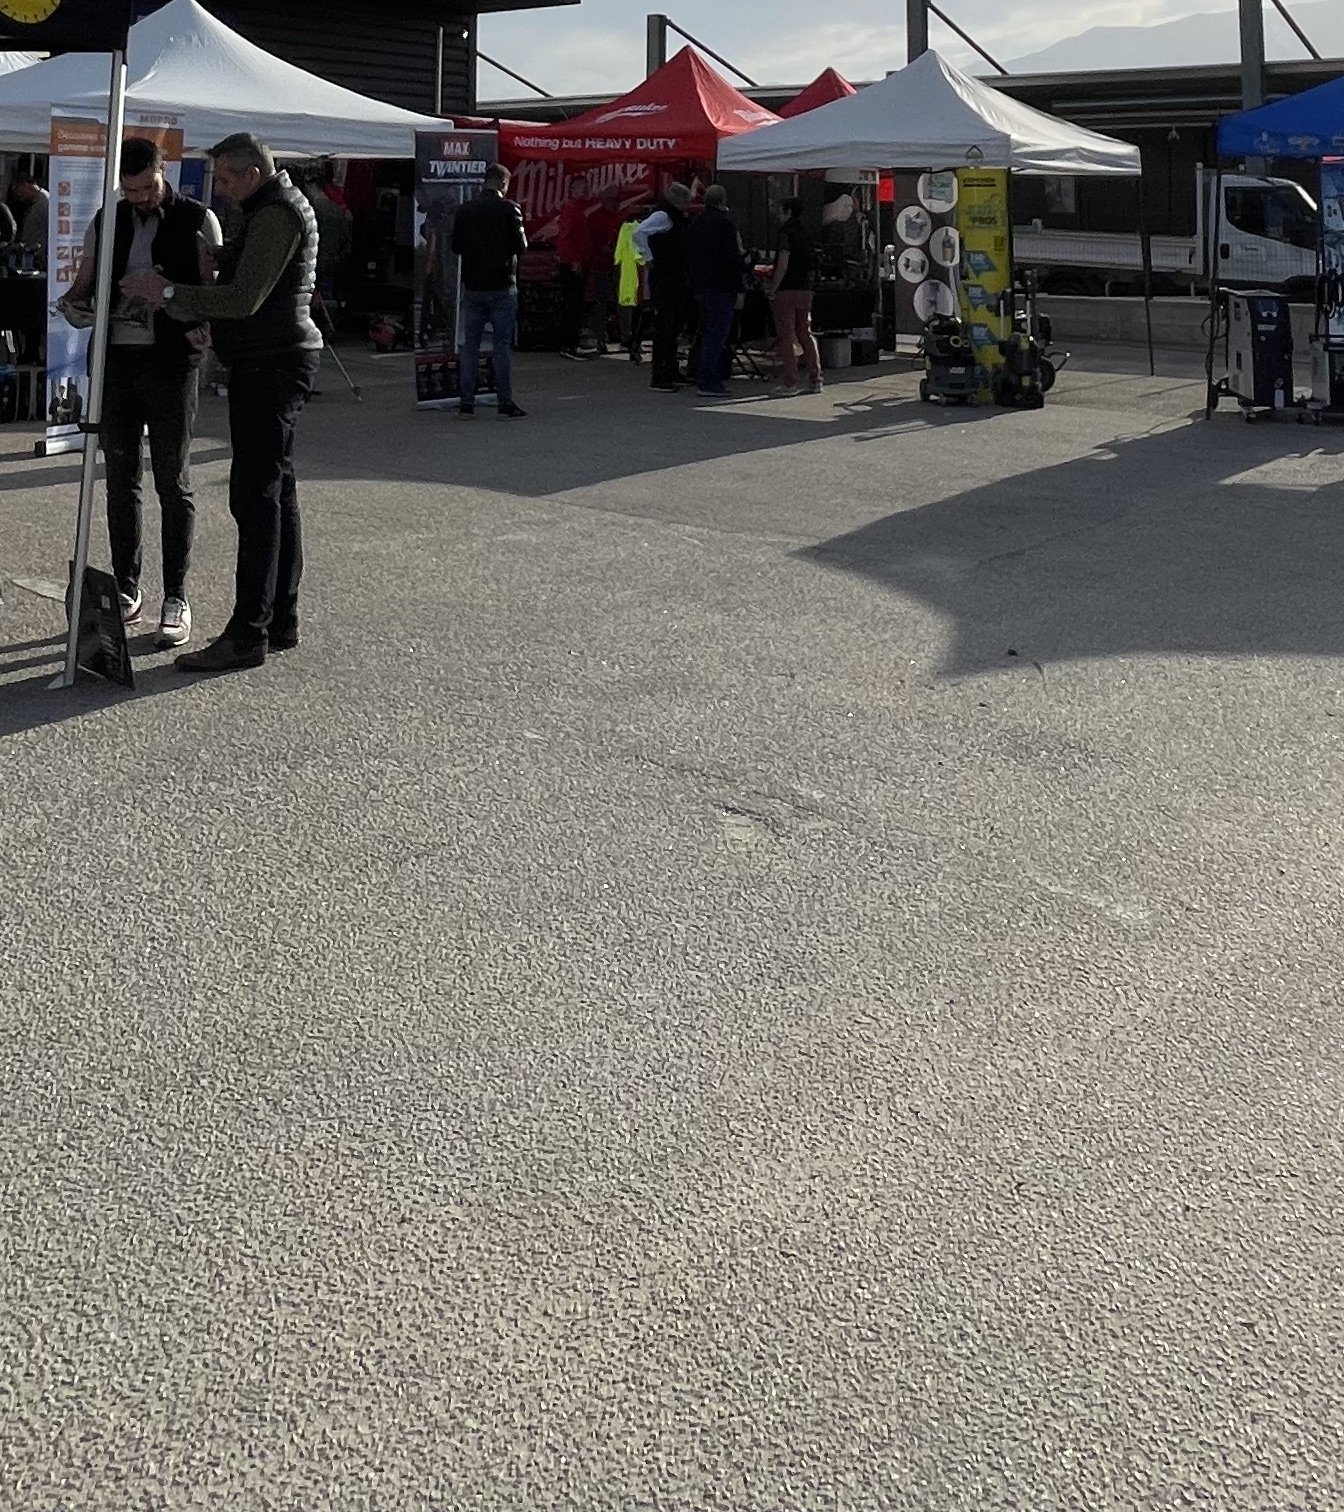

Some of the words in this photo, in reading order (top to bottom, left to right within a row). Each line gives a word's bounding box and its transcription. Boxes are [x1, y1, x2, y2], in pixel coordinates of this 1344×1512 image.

[443, 141, 470, 155] MAX
[513, 136, 560, 149] Nothing
[561, 137, 582, 149] but
[585, 138, 633, 150] HEAVY
[636, 138, 677, 150] DUTY
